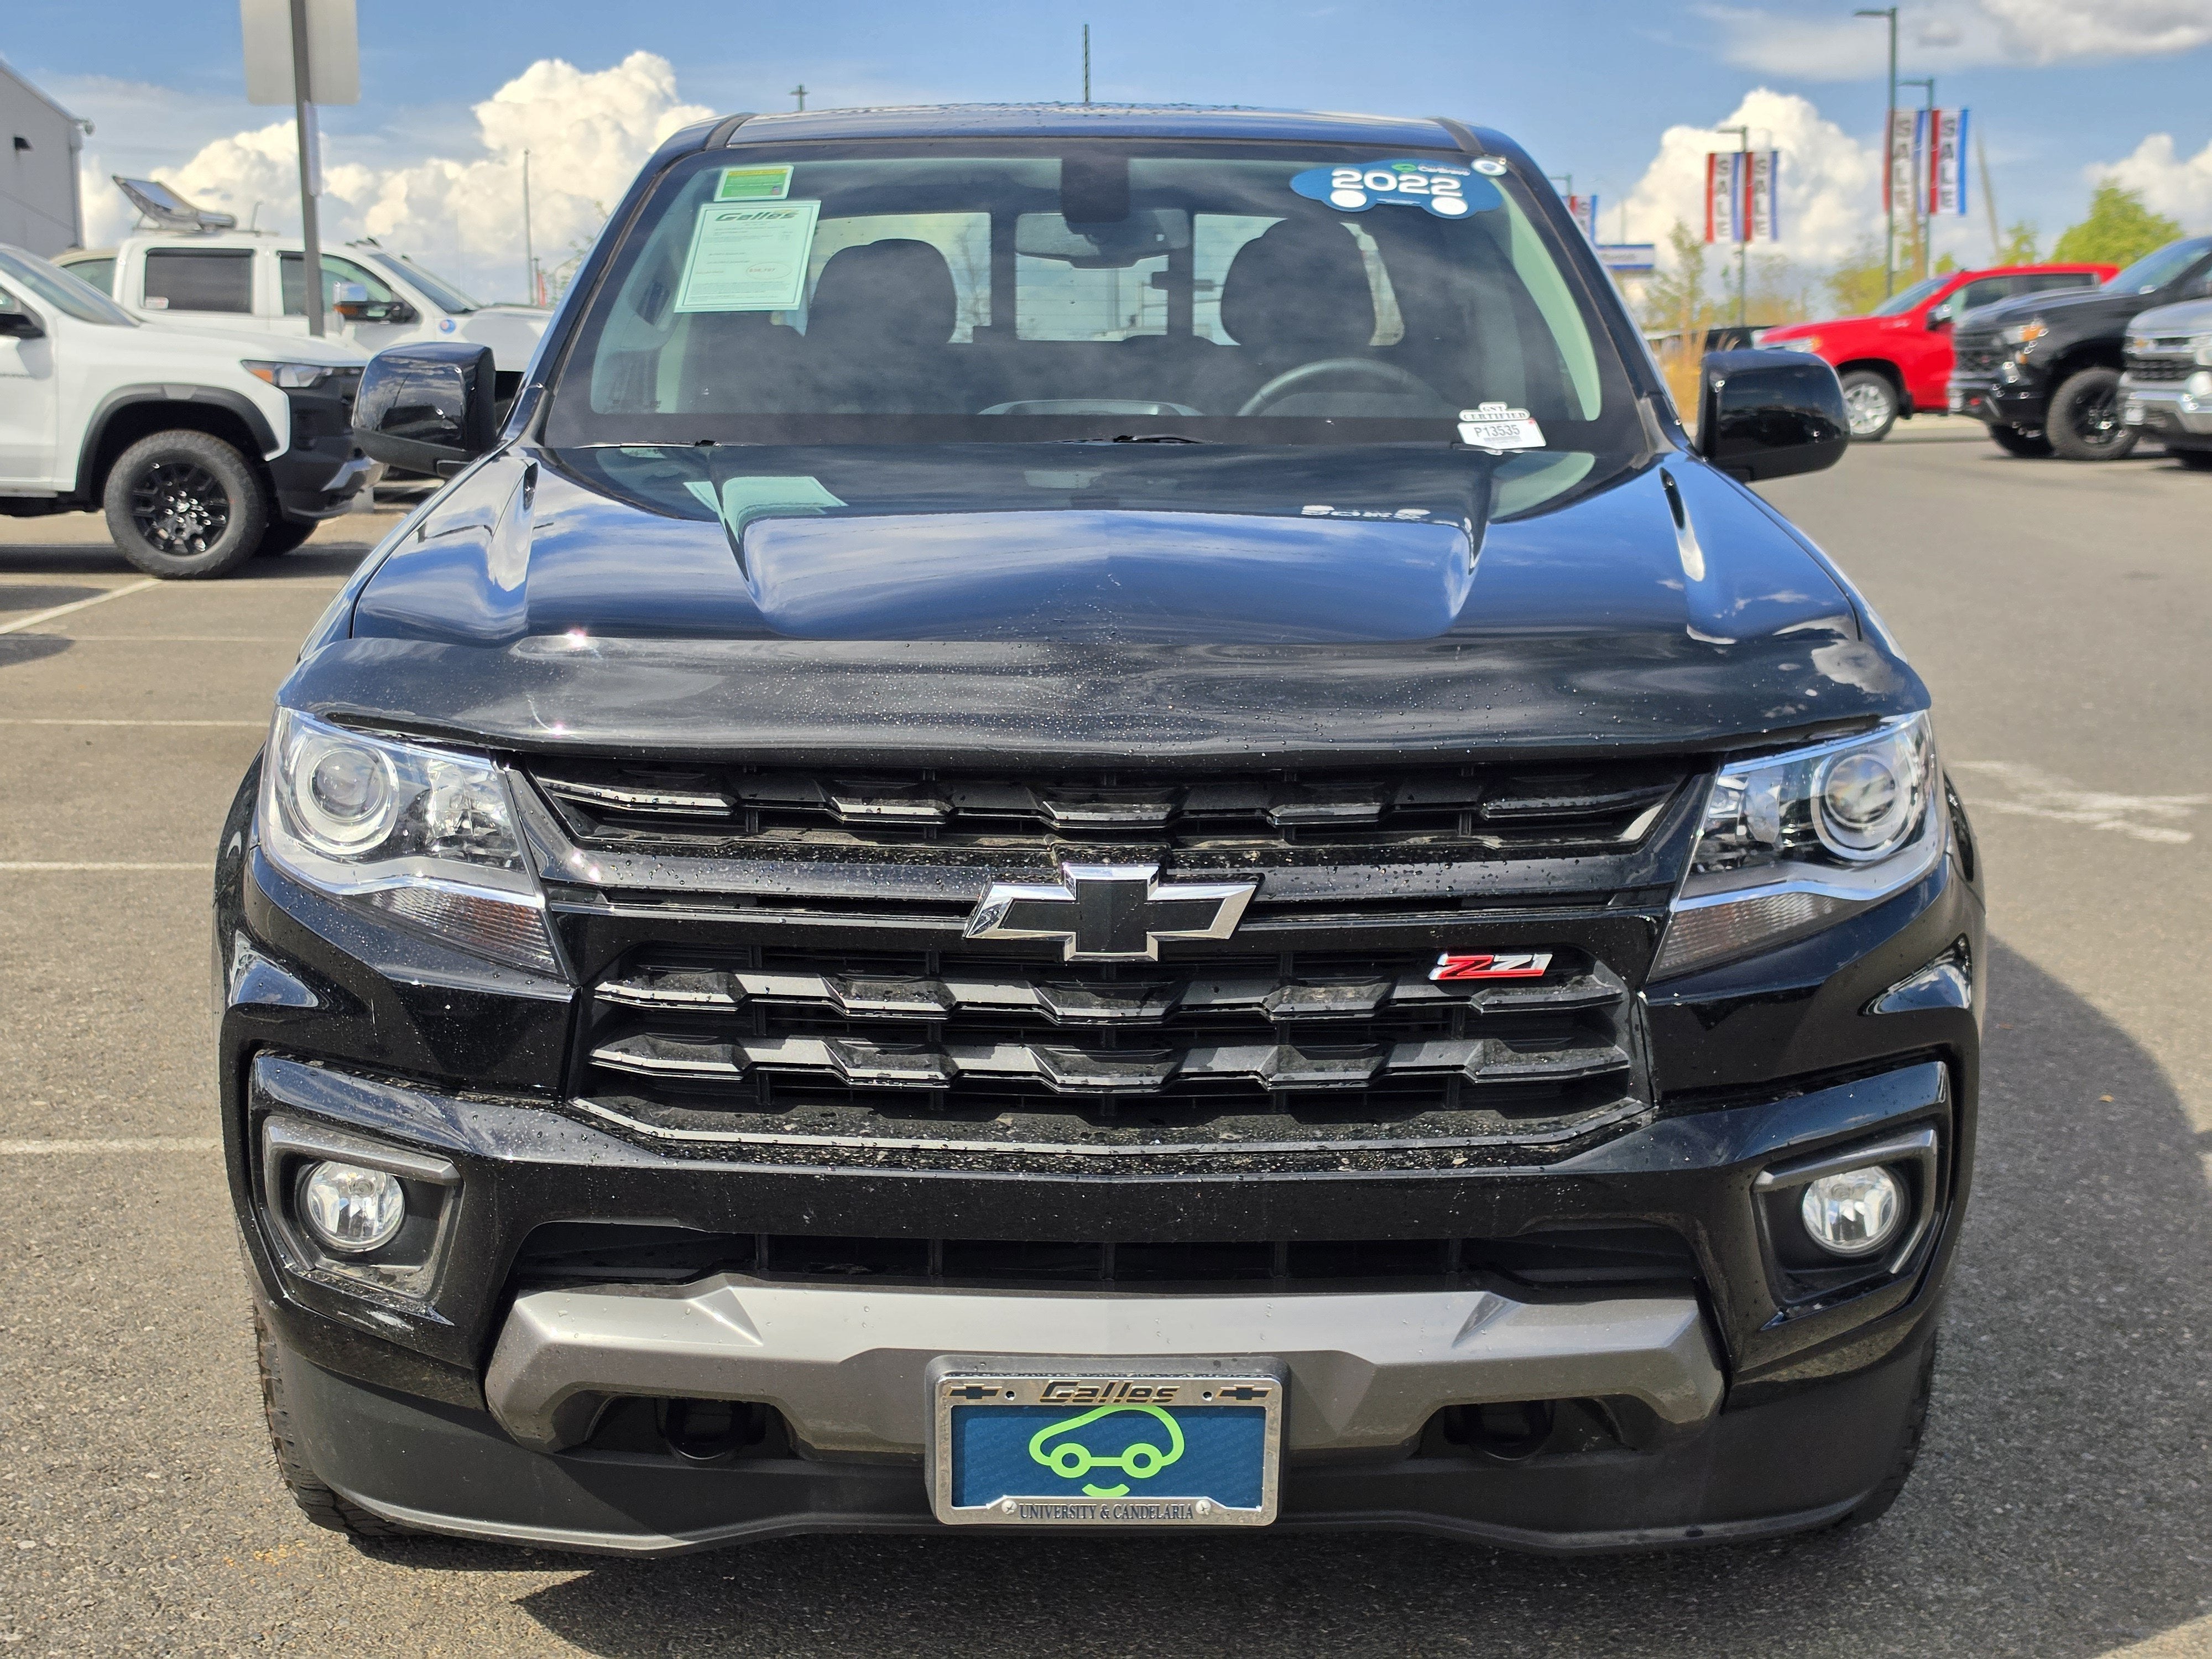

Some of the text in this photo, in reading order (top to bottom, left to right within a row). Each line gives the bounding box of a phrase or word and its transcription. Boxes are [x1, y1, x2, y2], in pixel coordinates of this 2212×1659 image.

[1894, 118, 1911, 208] SALE
[1940, 117, 1956, 207] SALE
[1331, 167, 1464, 197] 2022
[1716, 159, 1729, 236] SALE
[1754, 159, 1767, 235] SALE
[715, 212, 799, 221] Galles
[1474, 424, 1521, 437] P13535
[1428, 951, 1553, 980] Z71
[1040, 1379, 1181, 1403] Galles
[1019, 1503, 1194, 1520] UNIVERSITY & CANDELARIA
